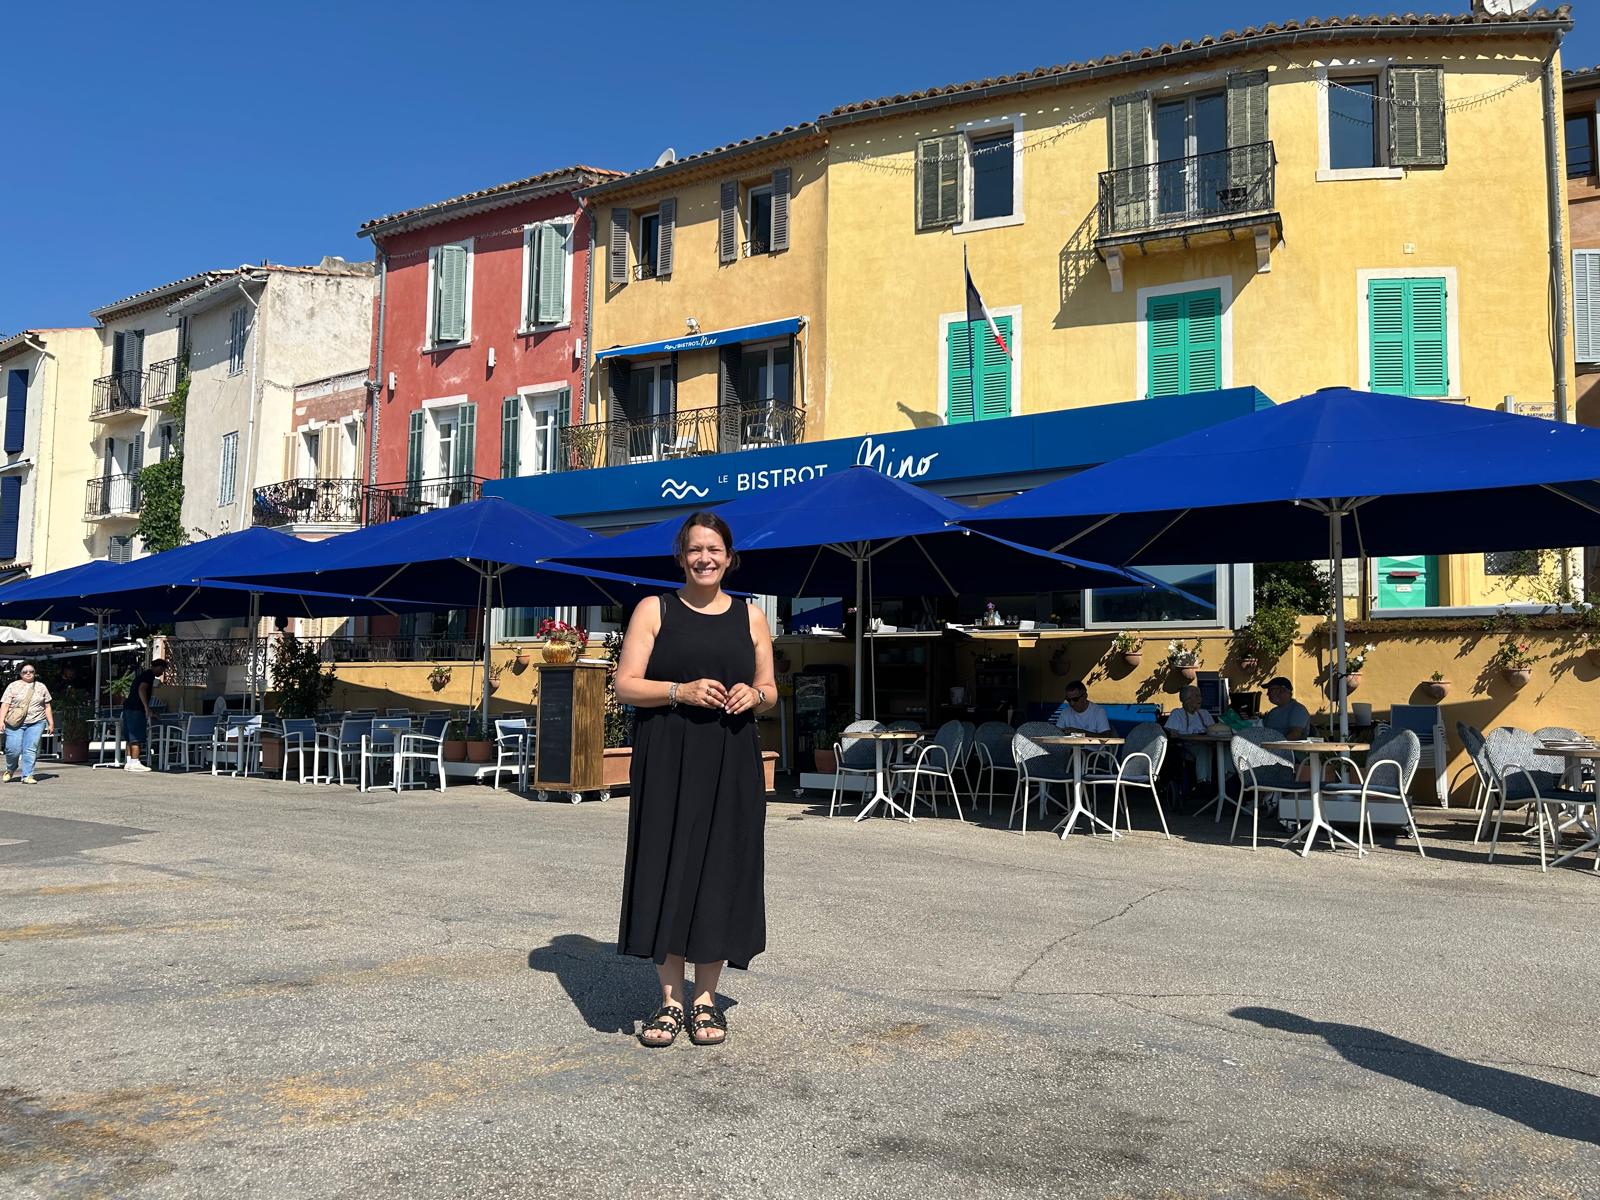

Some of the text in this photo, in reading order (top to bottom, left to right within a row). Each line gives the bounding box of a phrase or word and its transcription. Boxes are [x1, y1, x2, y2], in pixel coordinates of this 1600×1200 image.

[718, 437, 939, 491] LE BISTROT Nino
